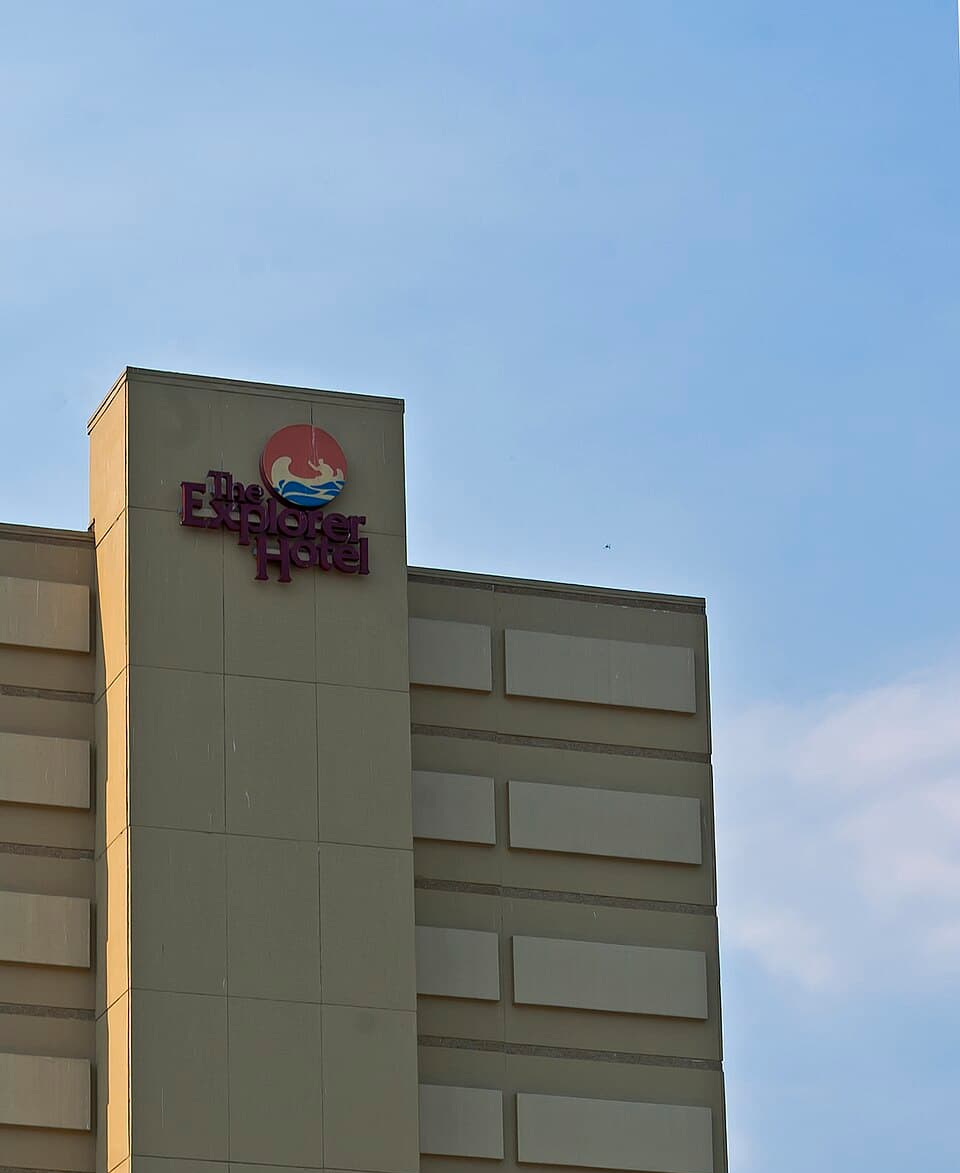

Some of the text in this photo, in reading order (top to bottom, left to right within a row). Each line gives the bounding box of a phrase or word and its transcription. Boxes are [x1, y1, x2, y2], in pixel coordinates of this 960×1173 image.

[207, 470, 264, 503] The
[180, 481, 366, 545] Explorer
[254, 536, 370, 582] Hotel
